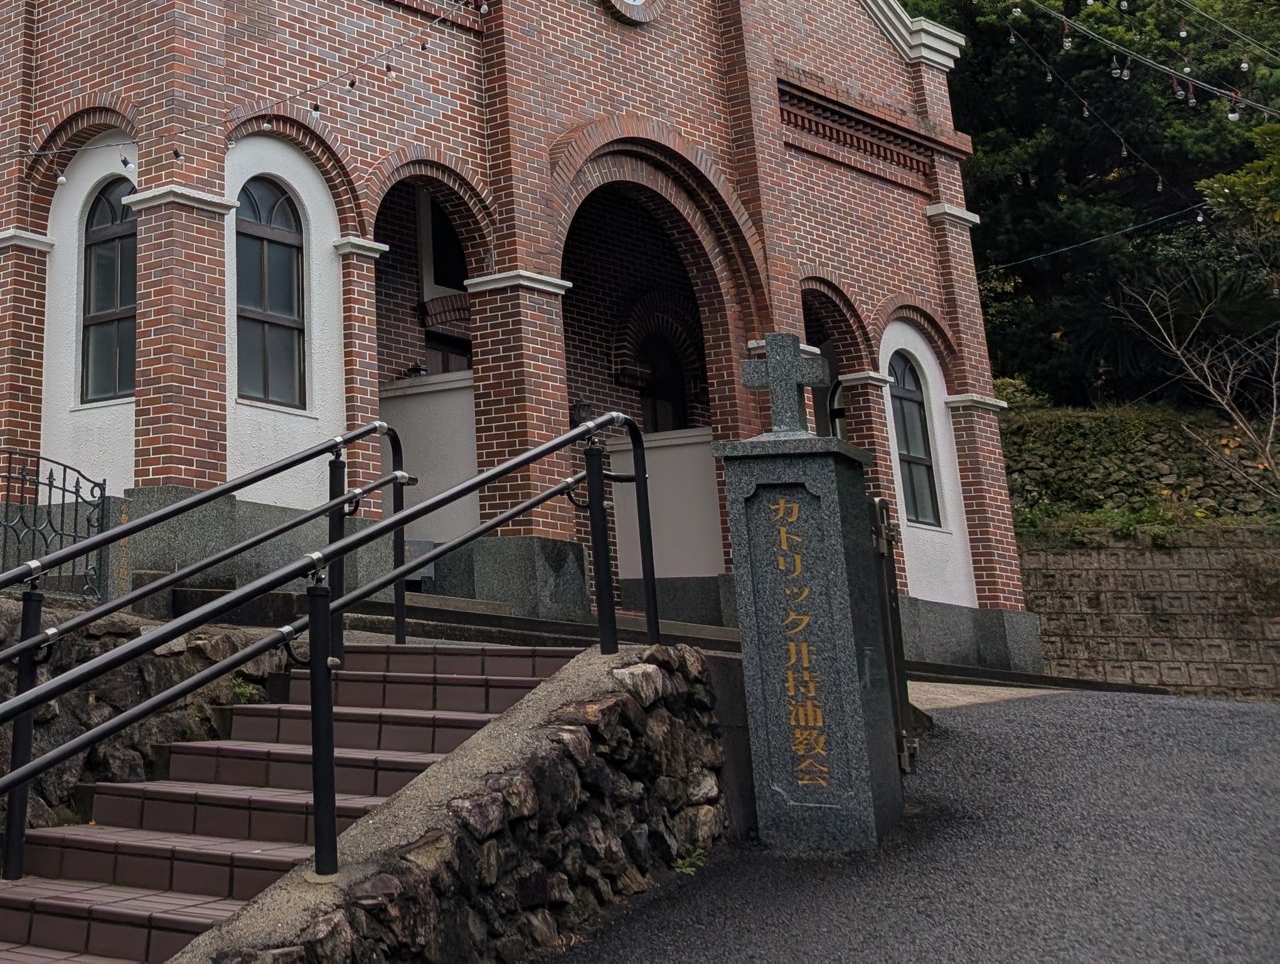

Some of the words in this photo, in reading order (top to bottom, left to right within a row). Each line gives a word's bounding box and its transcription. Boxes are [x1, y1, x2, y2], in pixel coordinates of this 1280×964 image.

[768, 498, 830, 788] カトリック井持浦教会
